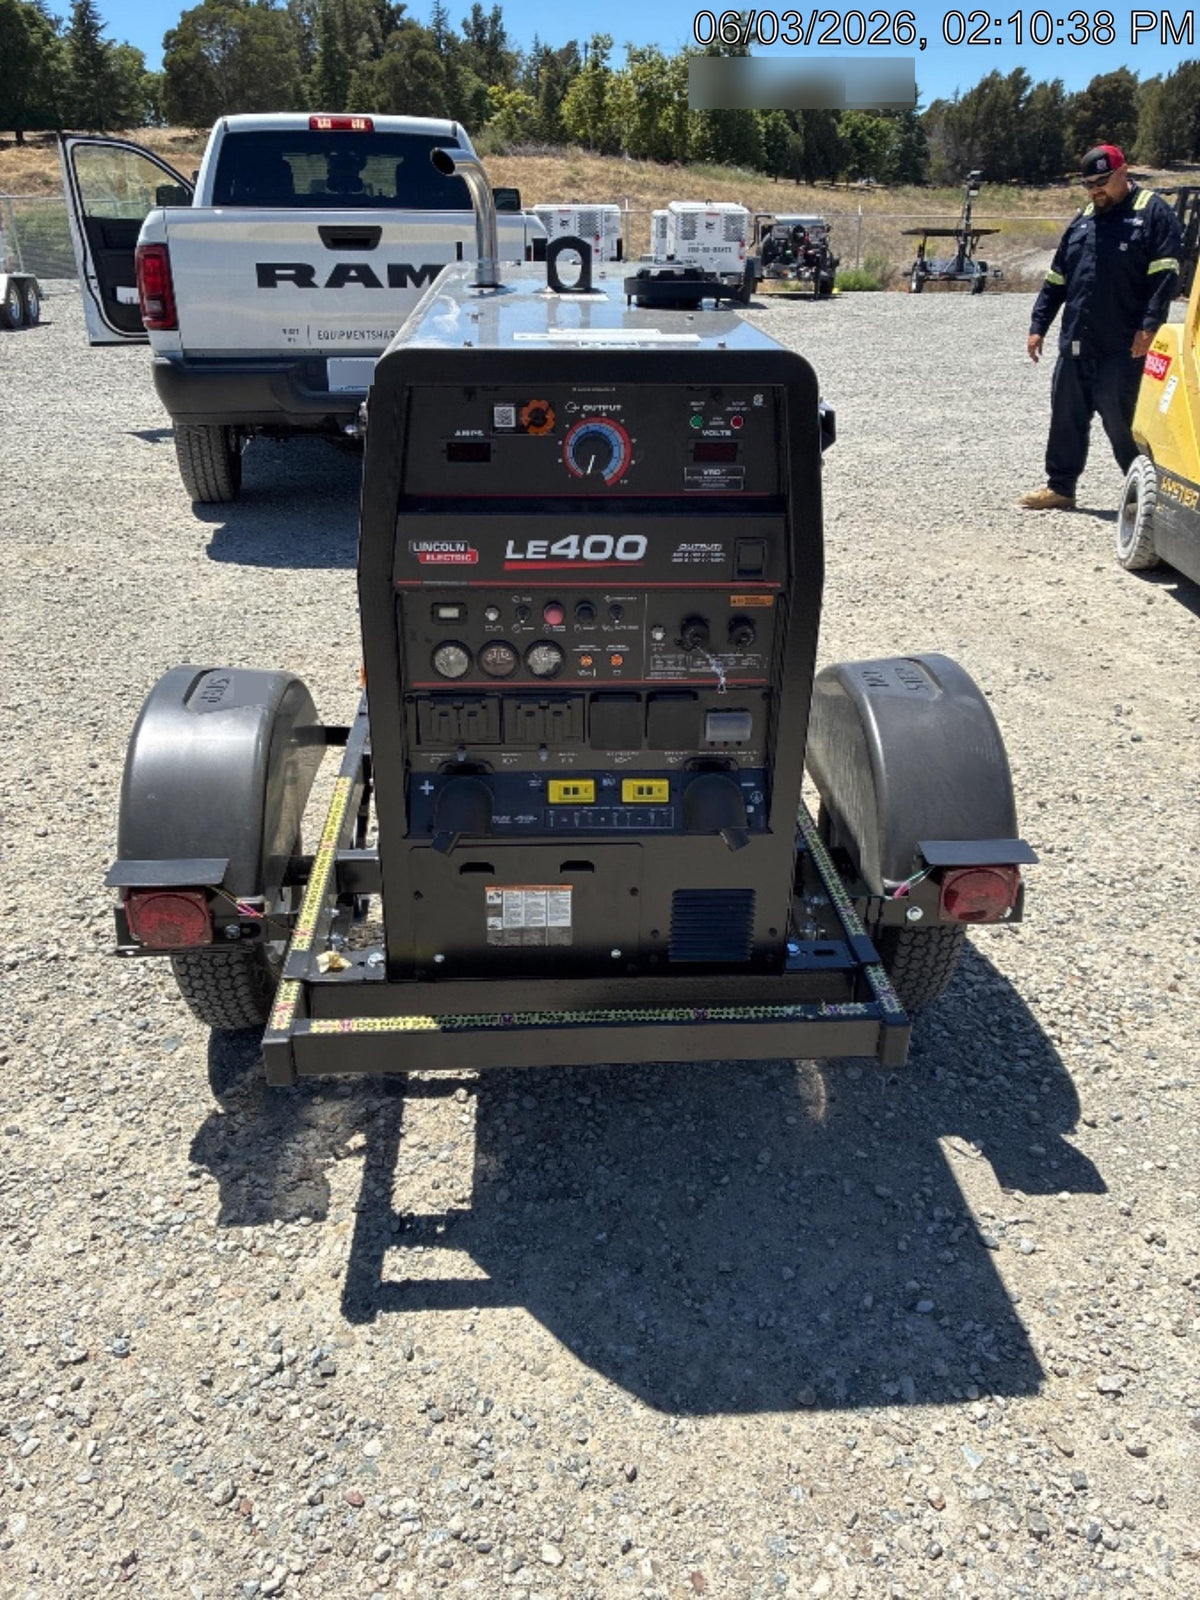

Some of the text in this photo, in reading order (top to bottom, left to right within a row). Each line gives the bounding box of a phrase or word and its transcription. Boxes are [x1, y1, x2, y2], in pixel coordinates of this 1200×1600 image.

[256, 263, 447, 288] RAM
[317, 329, 400, 341] EQUIPMENTSHAR
[455, 429, 484, 437] AMPS
[412, 543, 465, 552] LINCOLN
[505, 534, 648, 561] LE400
[426, 553, 472, 562] ELECTRIC
[379, 1018, 408, 1028] NOT
